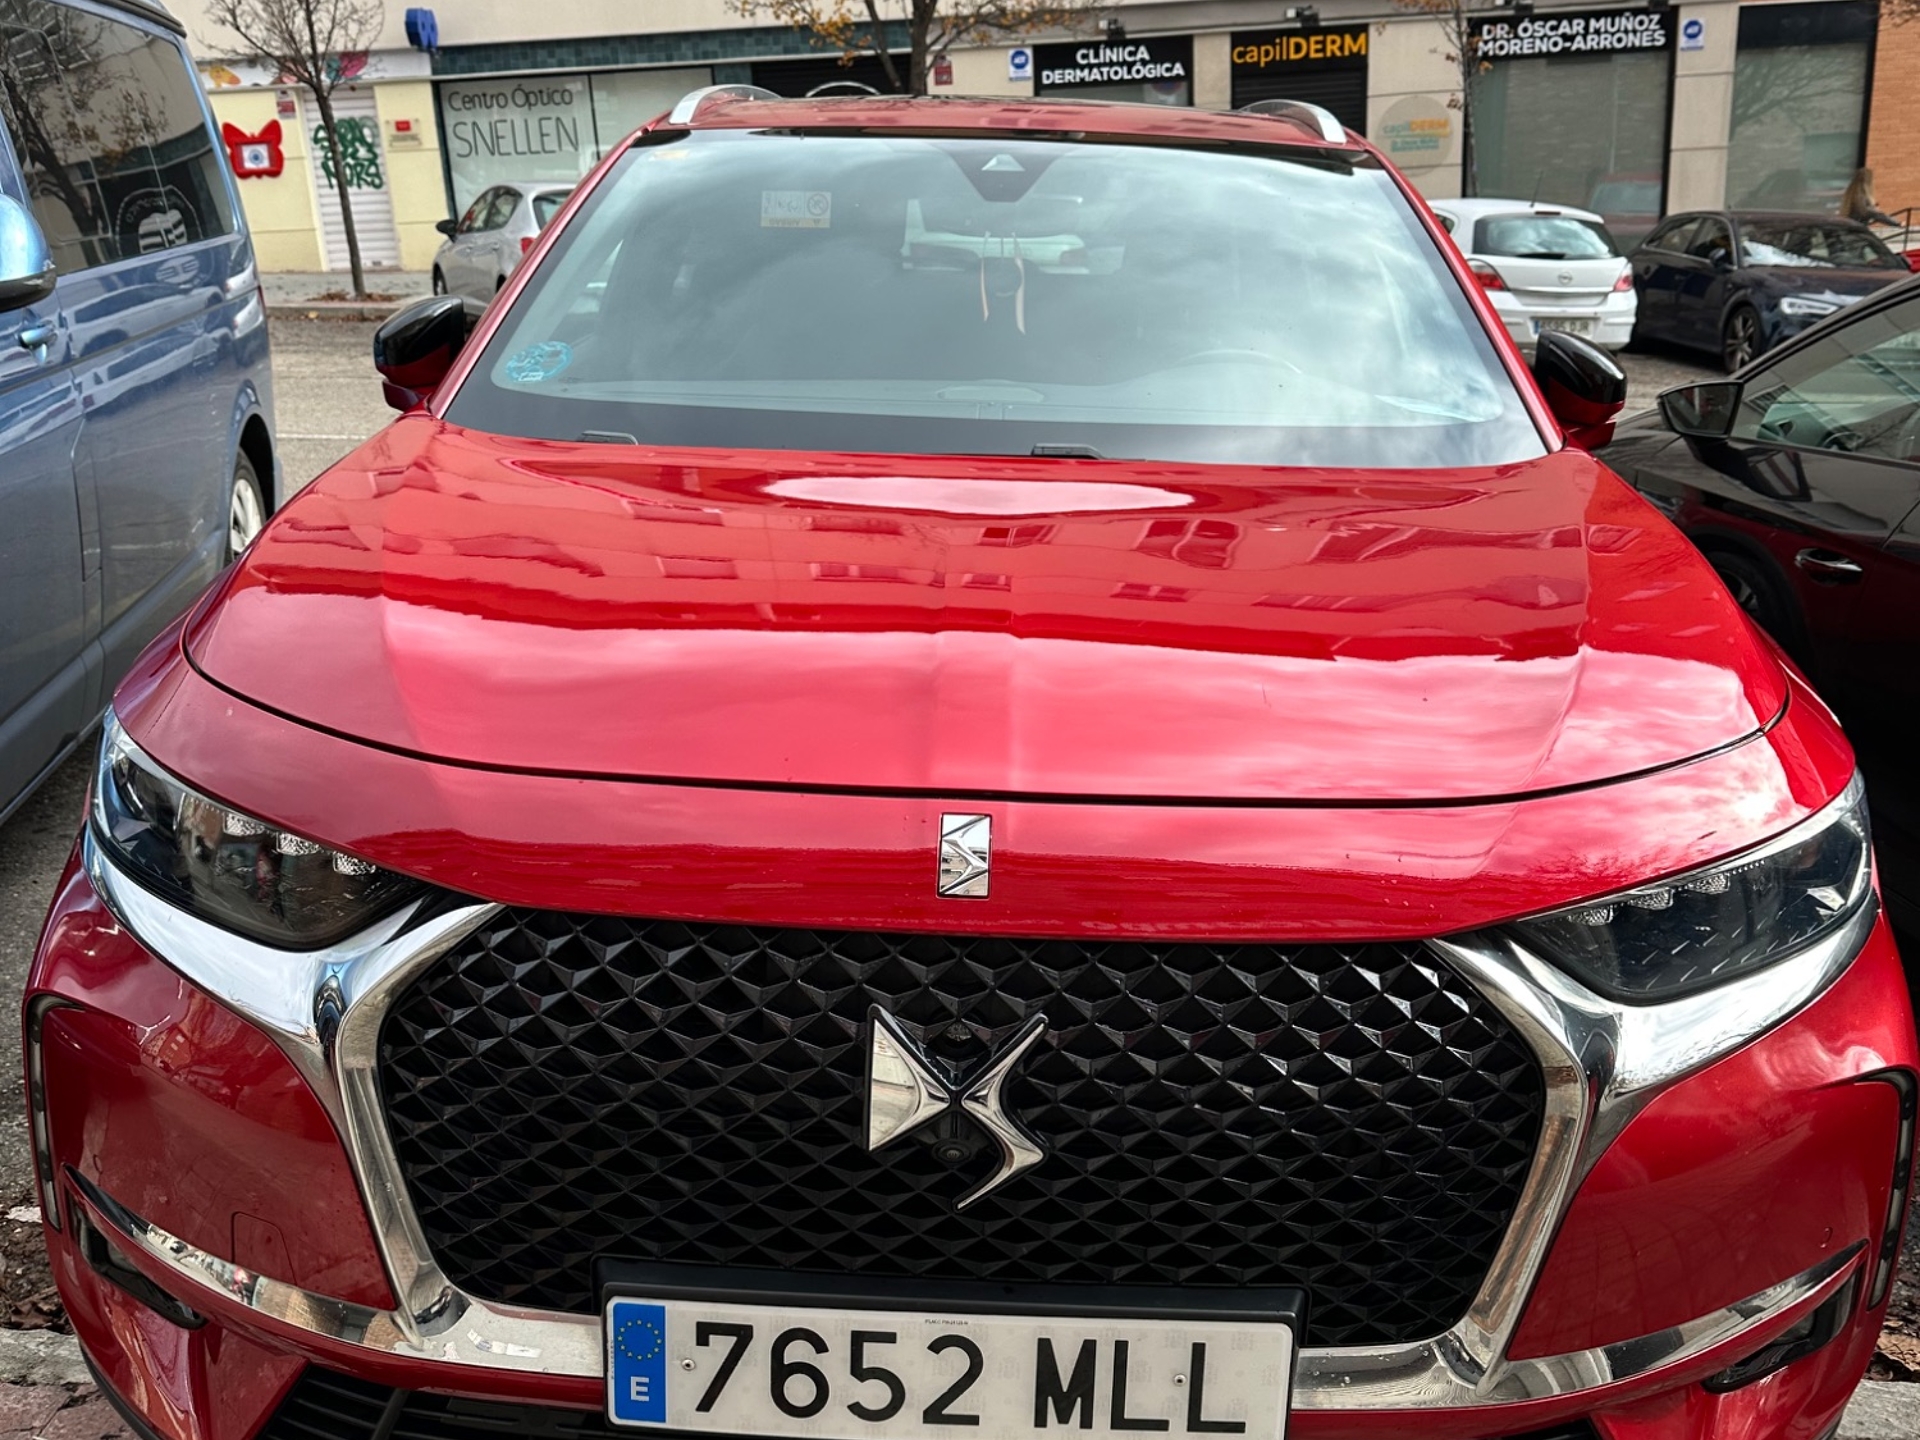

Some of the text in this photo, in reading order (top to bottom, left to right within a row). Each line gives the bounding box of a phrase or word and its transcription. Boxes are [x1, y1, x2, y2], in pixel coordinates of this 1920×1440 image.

[1482, 12, 1662, 40] DR. ÓSCAR MUÑOZ
[1075, 44, 1150, 64] CLÍNICA
[1232, 32, 1368, 67] capilDERM
[1477, 29, 1667, 57] MORENO-ARRONES
[1041, 61, 1186, 85] DERMATOLÓGICA
[448, 83, 574, 112] Centro Óptico
[452, 116, 580, 158] SNELLEN
[630, 1376, 650, 1402] E
[695, 1320, 984, 1427] 7652
[1033, 1337, 1247, 1434] MLL
